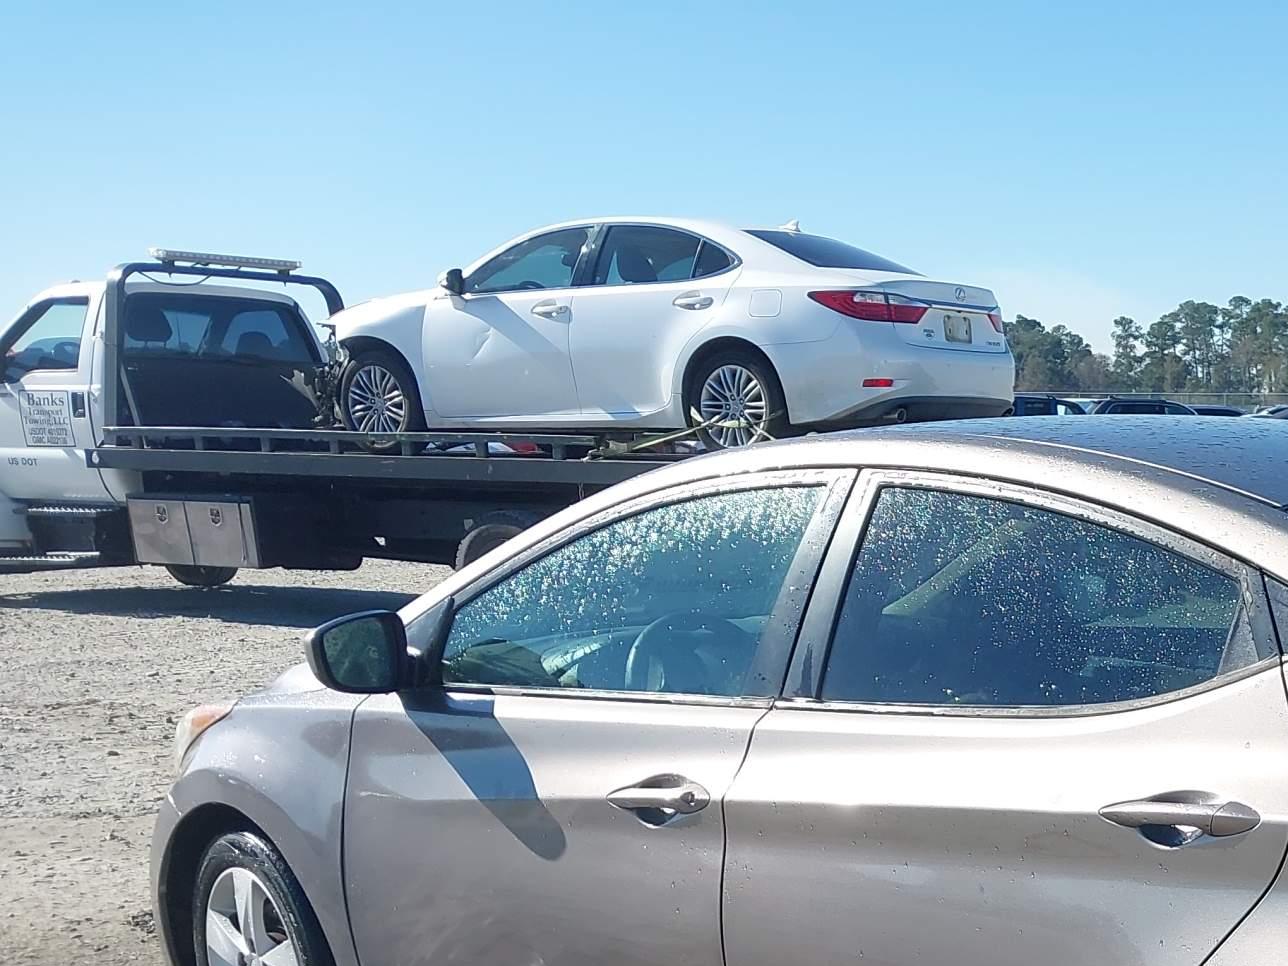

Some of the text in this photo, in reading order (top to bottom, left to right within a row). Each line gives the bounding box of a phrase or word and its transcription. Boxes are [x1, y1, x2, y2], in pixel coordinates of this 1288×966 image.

[26, 393, 65, 406] Banks
[28, 407, 63, 418] Transport
[8, 457, 38, 466] US DOT
